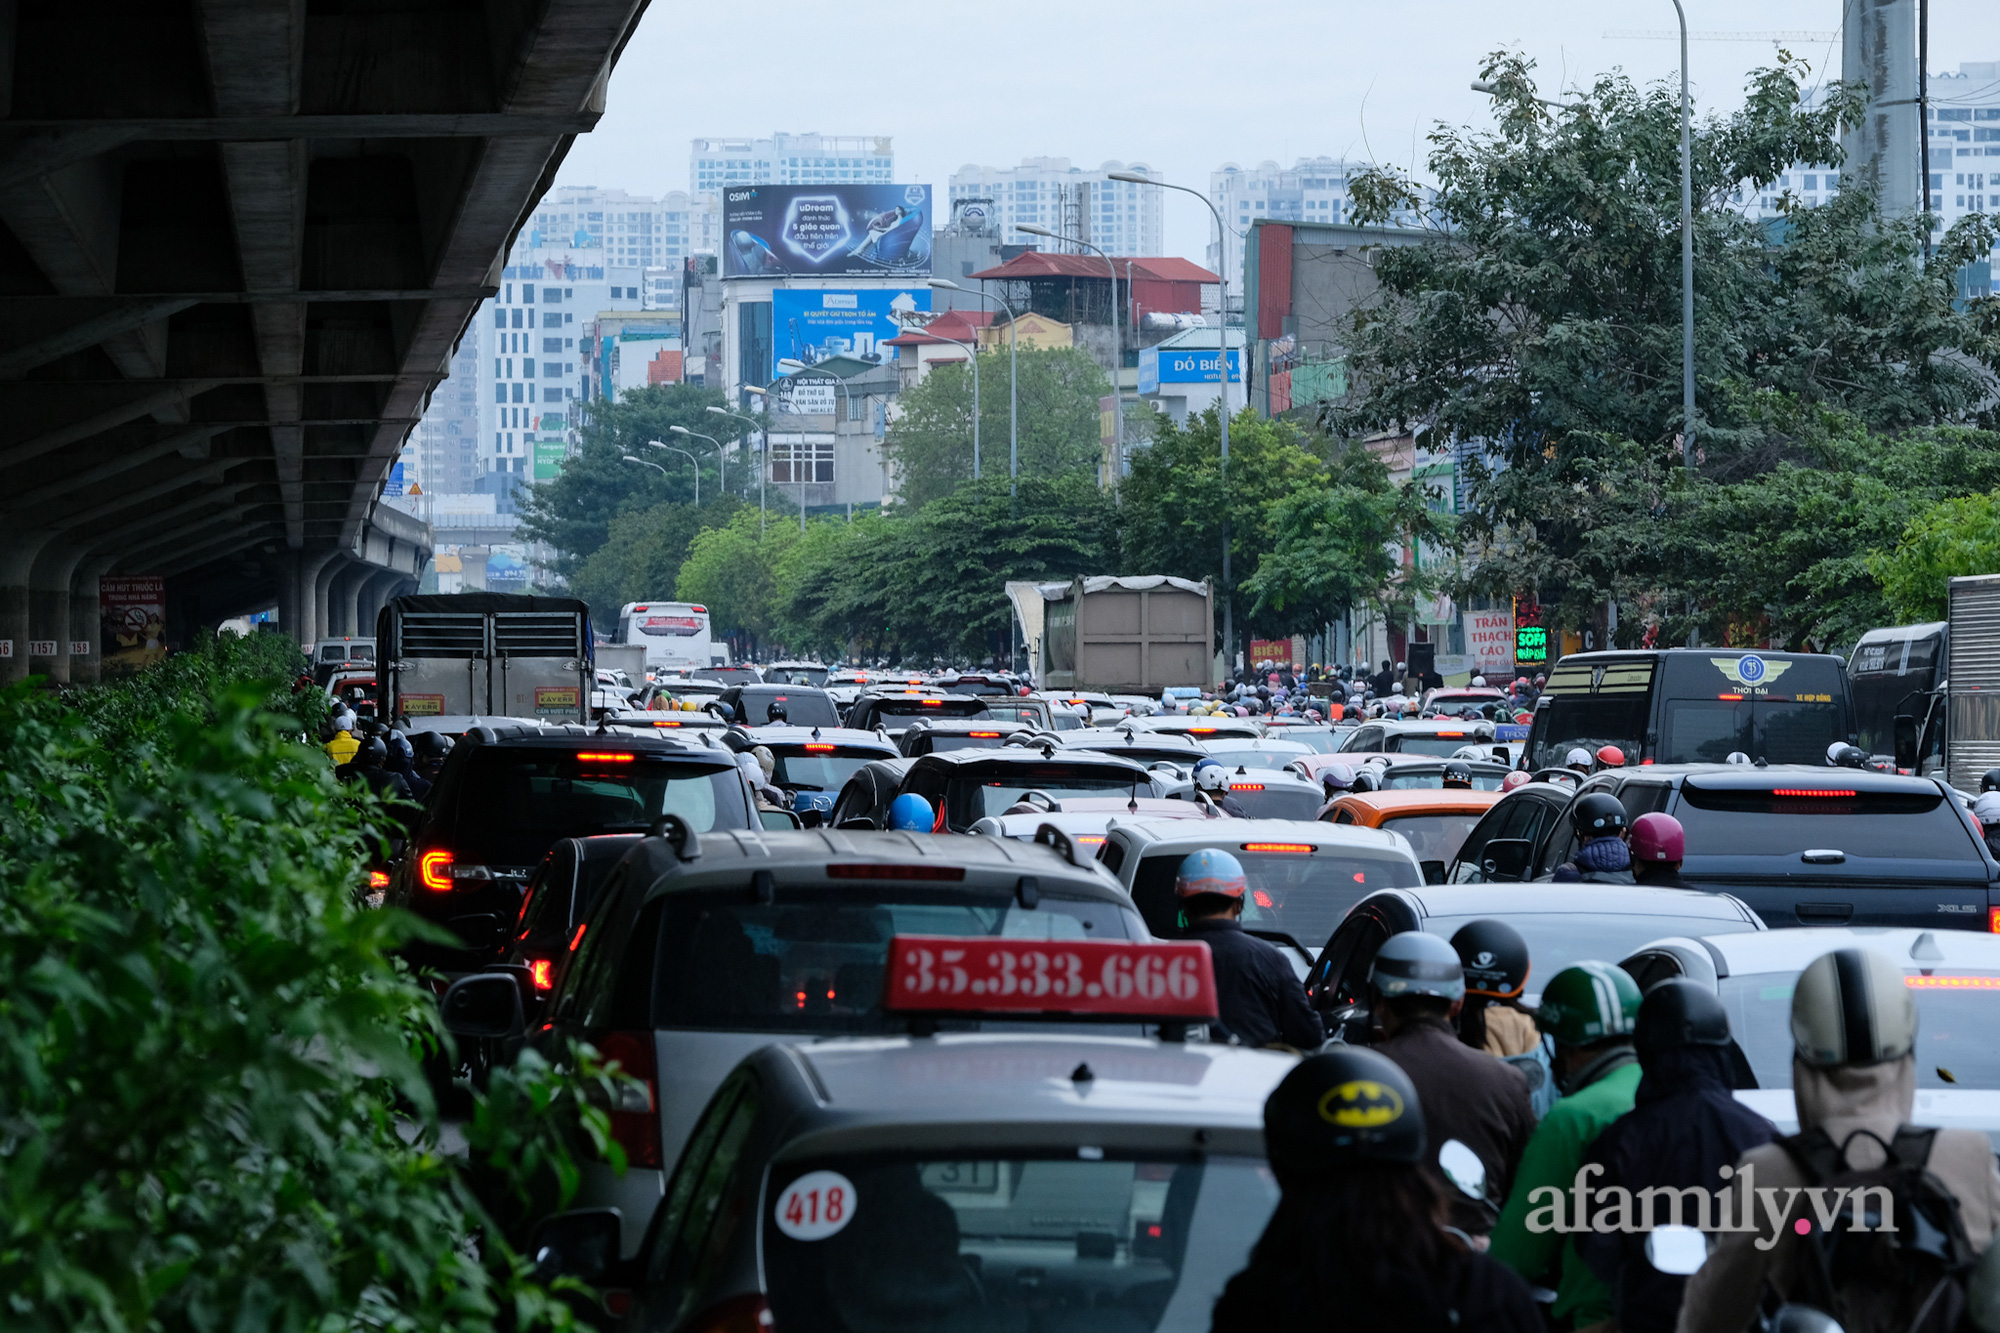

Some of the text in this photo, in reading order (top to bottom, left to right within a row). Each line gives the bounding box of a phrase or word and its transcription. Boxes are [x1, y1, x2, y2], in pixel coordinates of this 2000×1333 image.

[799, 204, 834, 212] uDream
[819, 223, 840, 232] quan
[131, 581, 154, 592] THUỐC
[1471, 630, 1512, 645] THẠCH
[1518, 632, 1547, 647] SOFA
[1480, 645, 1506, 656] CAO
[1755, 687, 1769, 695] ĐẠI
[1937, 904, 1977, 913] XLS
[905, 949, 1200, 1000] 35.333.666
[785, 1186, 845, 1227] 418
